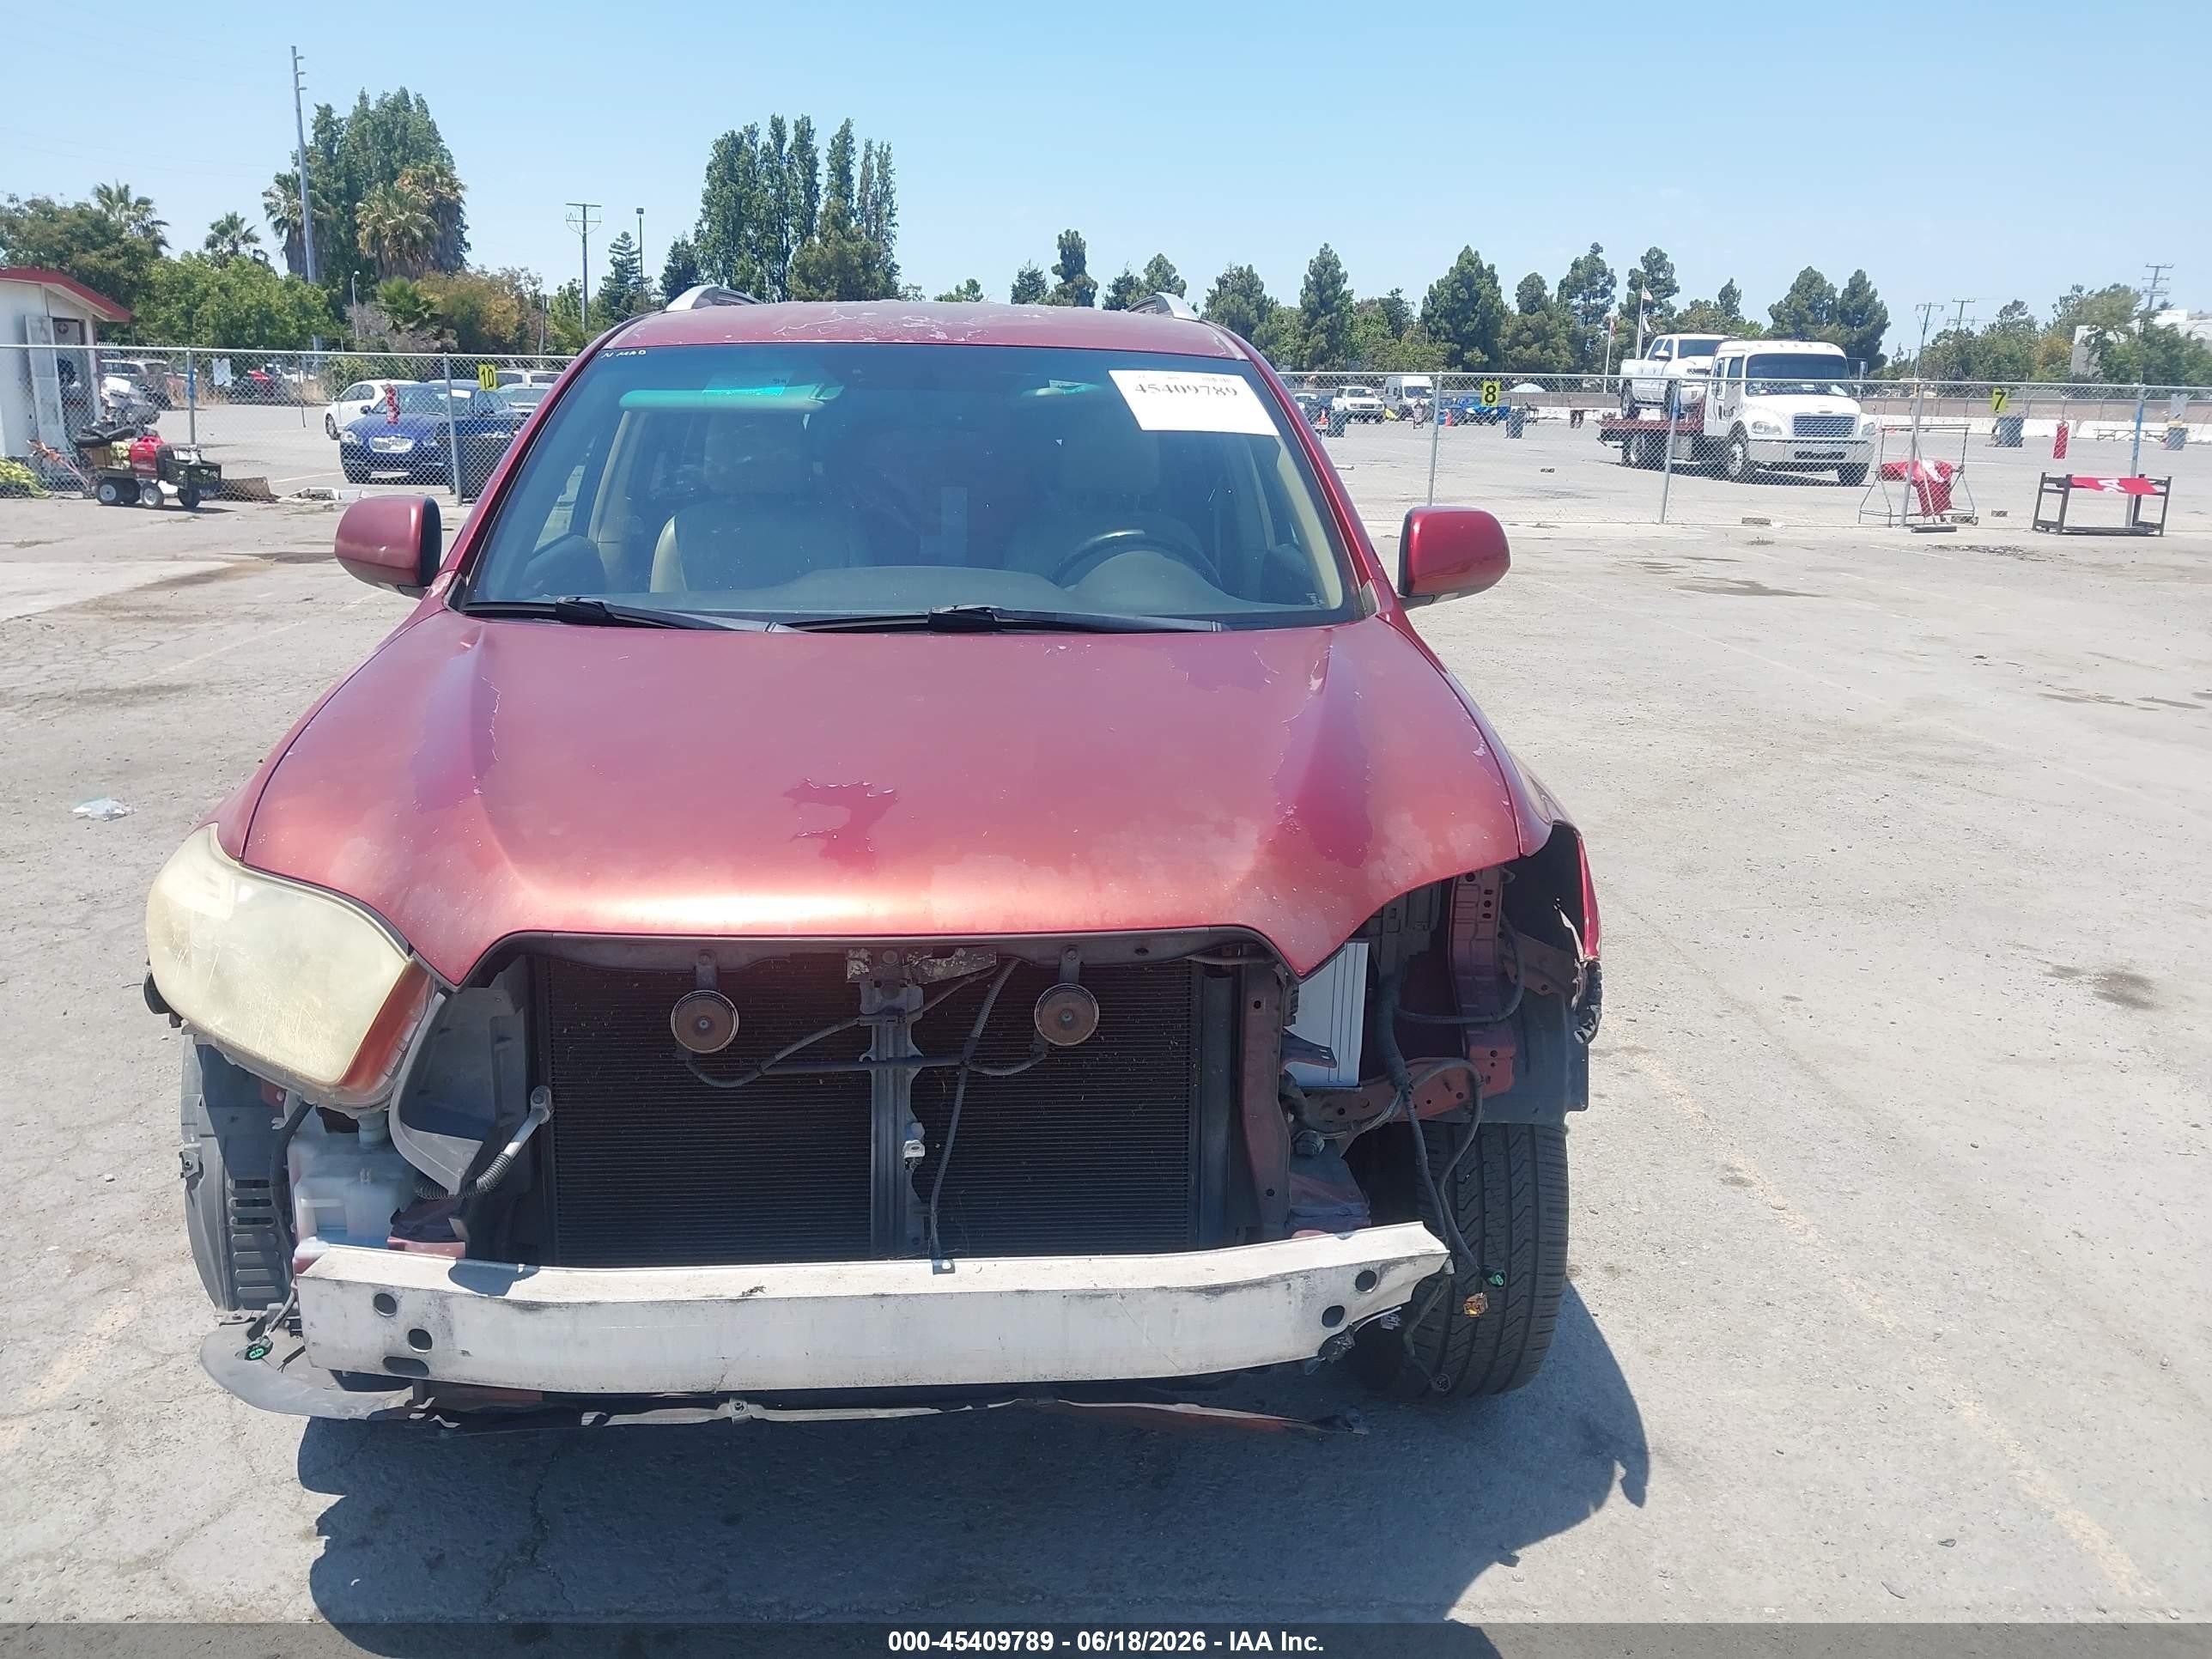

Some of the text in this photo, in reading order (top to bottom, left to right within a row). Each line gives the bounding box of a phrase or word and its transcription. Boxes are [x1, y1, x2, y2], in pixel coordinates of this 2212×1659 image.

[481, 368, 495, 390] 10
[1485, 385, 1497, 404] 8
[1995, 392, 2007, 411] 7
